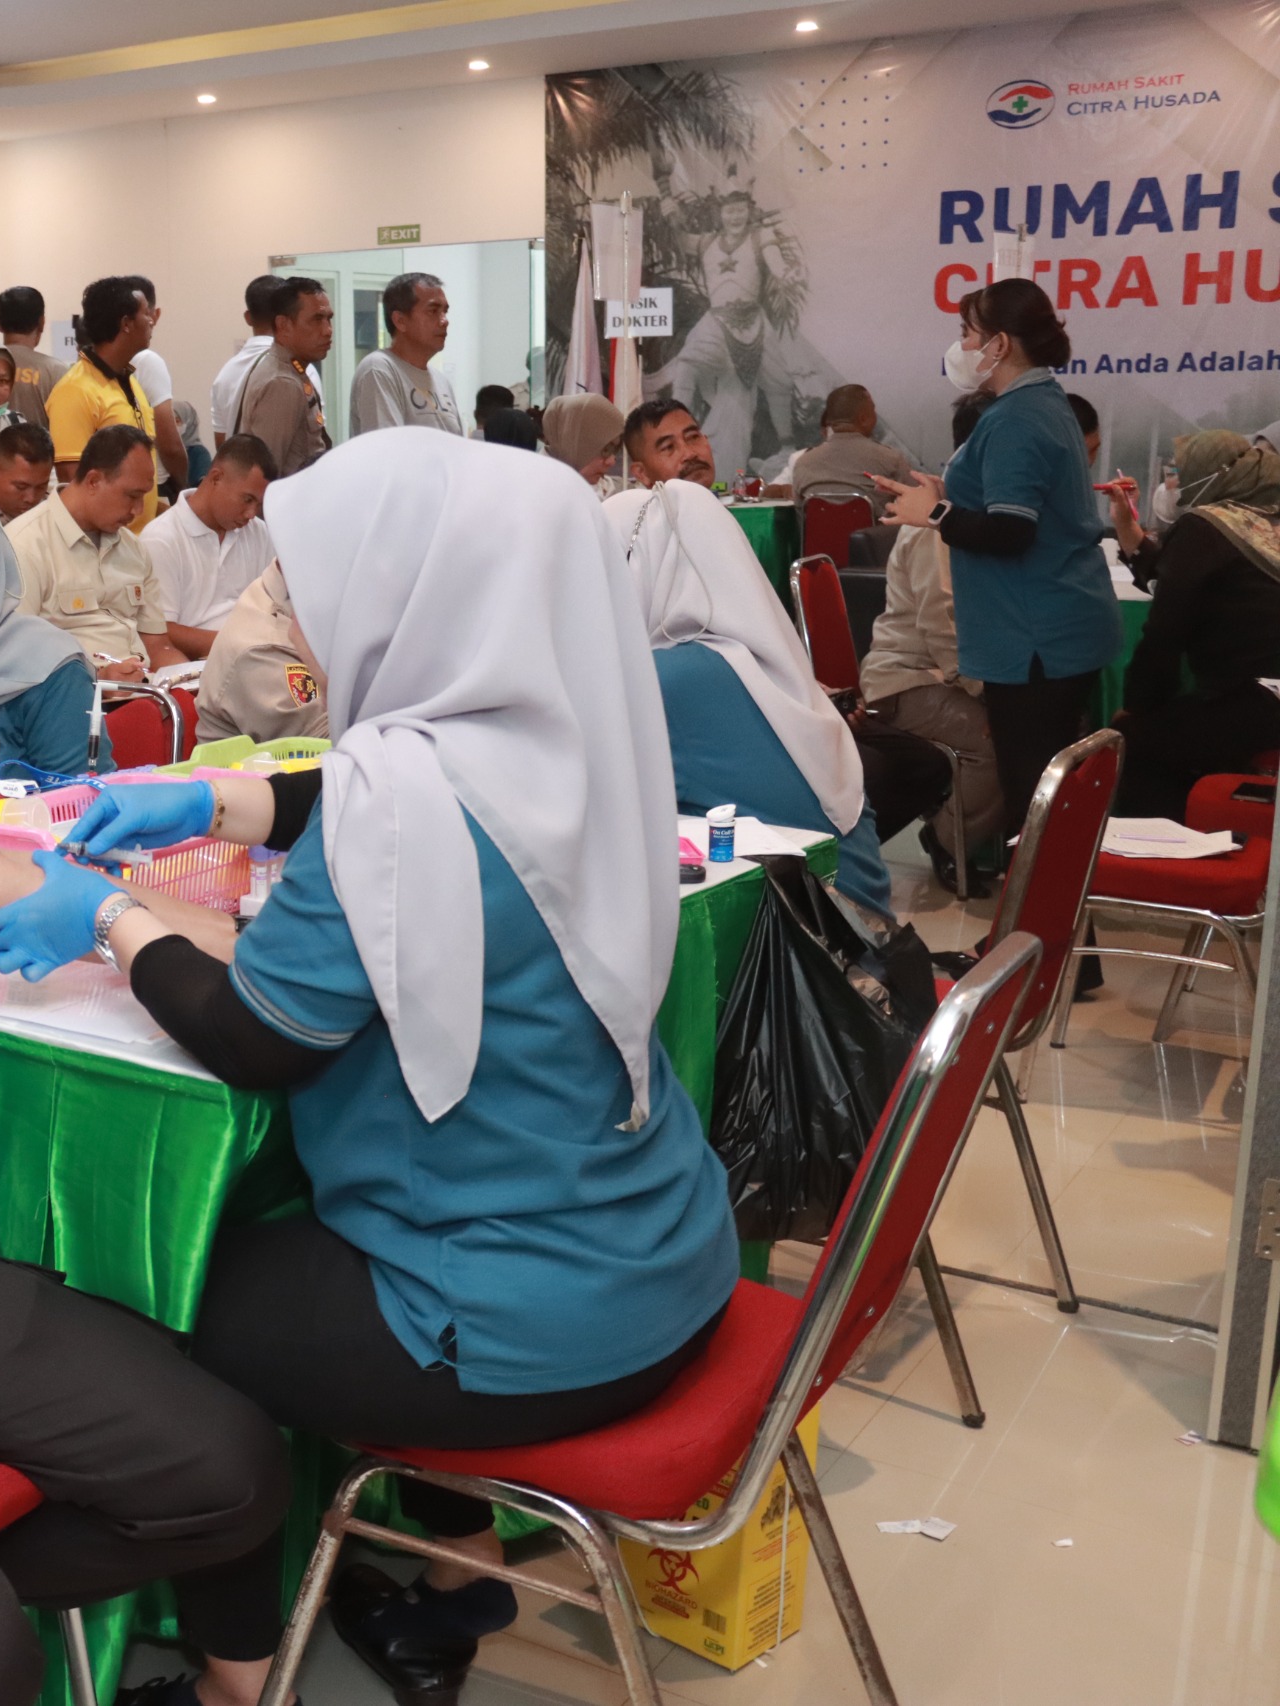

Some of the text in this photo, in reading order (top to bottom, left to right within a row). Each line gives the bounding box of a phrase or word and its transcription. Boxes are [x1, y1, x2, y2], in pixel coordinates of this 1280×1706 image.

[1067, 74, 1185, 96] RUMAH SAKIT
[1066, 90, 1221, 116] CITRA HUSADA
[938, 170, 1240, 245] RUMAH
[390, 228, 419, 241] EXIT
[933, 255, 1159, 314] CRA
[1094, 352, 1169, 374] Anda
